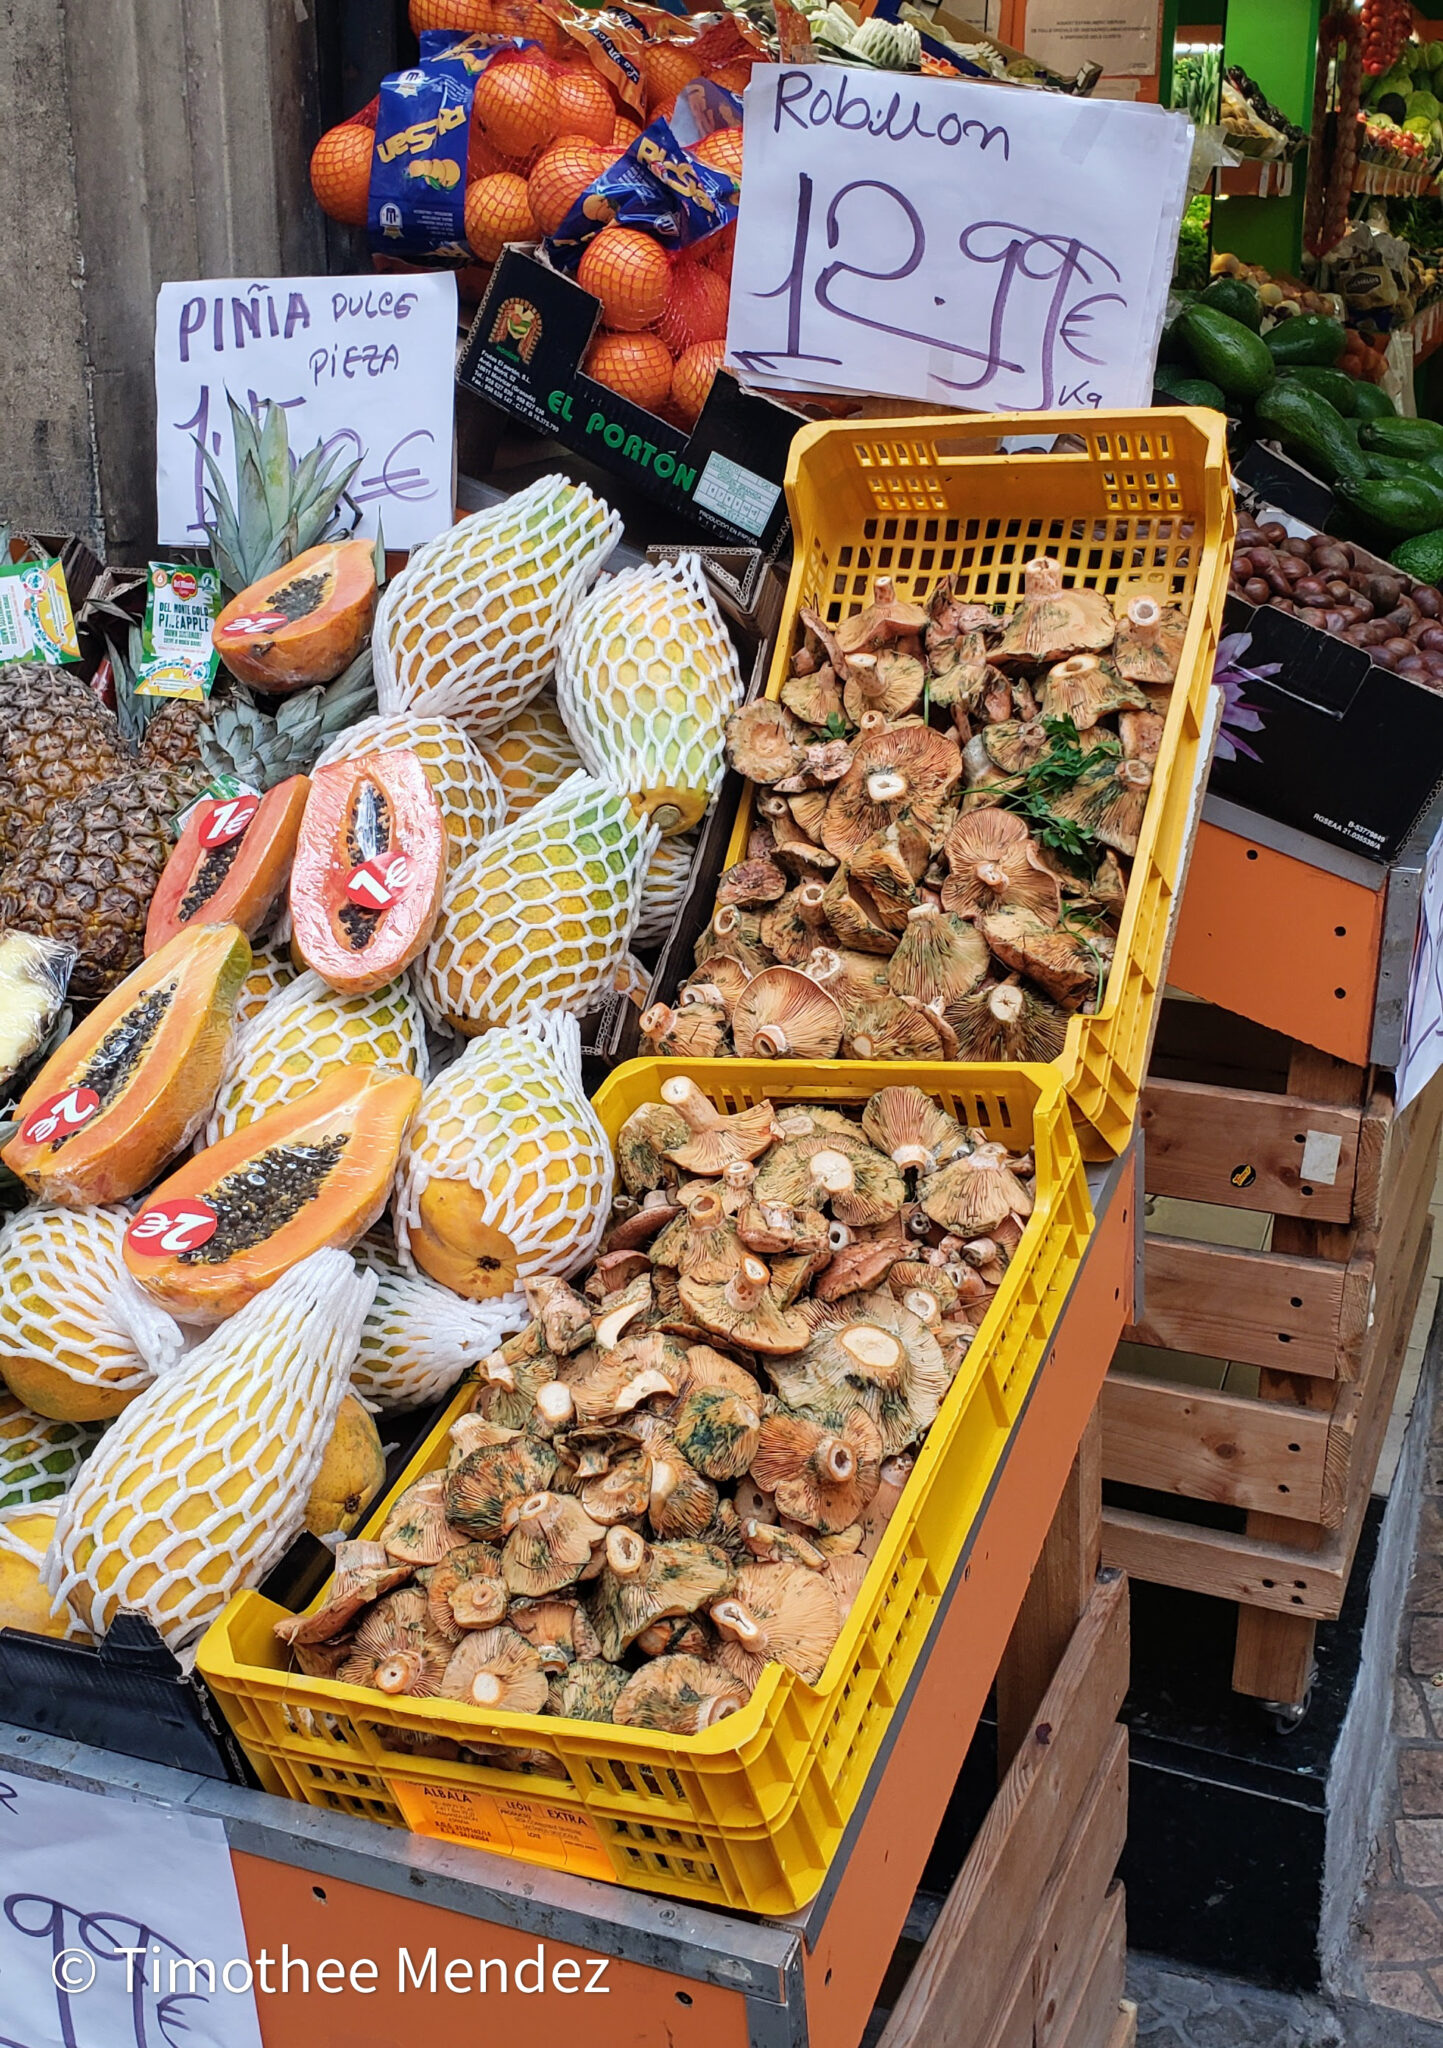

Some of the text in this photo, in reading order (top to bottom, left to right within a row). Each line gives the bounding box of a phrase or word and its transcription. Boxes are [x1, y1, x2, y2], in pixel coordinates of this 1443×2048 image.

[547, 390, 574, 422] EL
[585, 411, 697, 492] PORTÓN
[191, 605, 209, 616] GOLD
[207, 801, 254, 839] 1€
[348, 857, 415, 904] 1€
[27, 1090, 95, 1142] 2€
[131, 1213, 215, 1250] 2€
[546, 1809, 588, 1827] EXTRA
